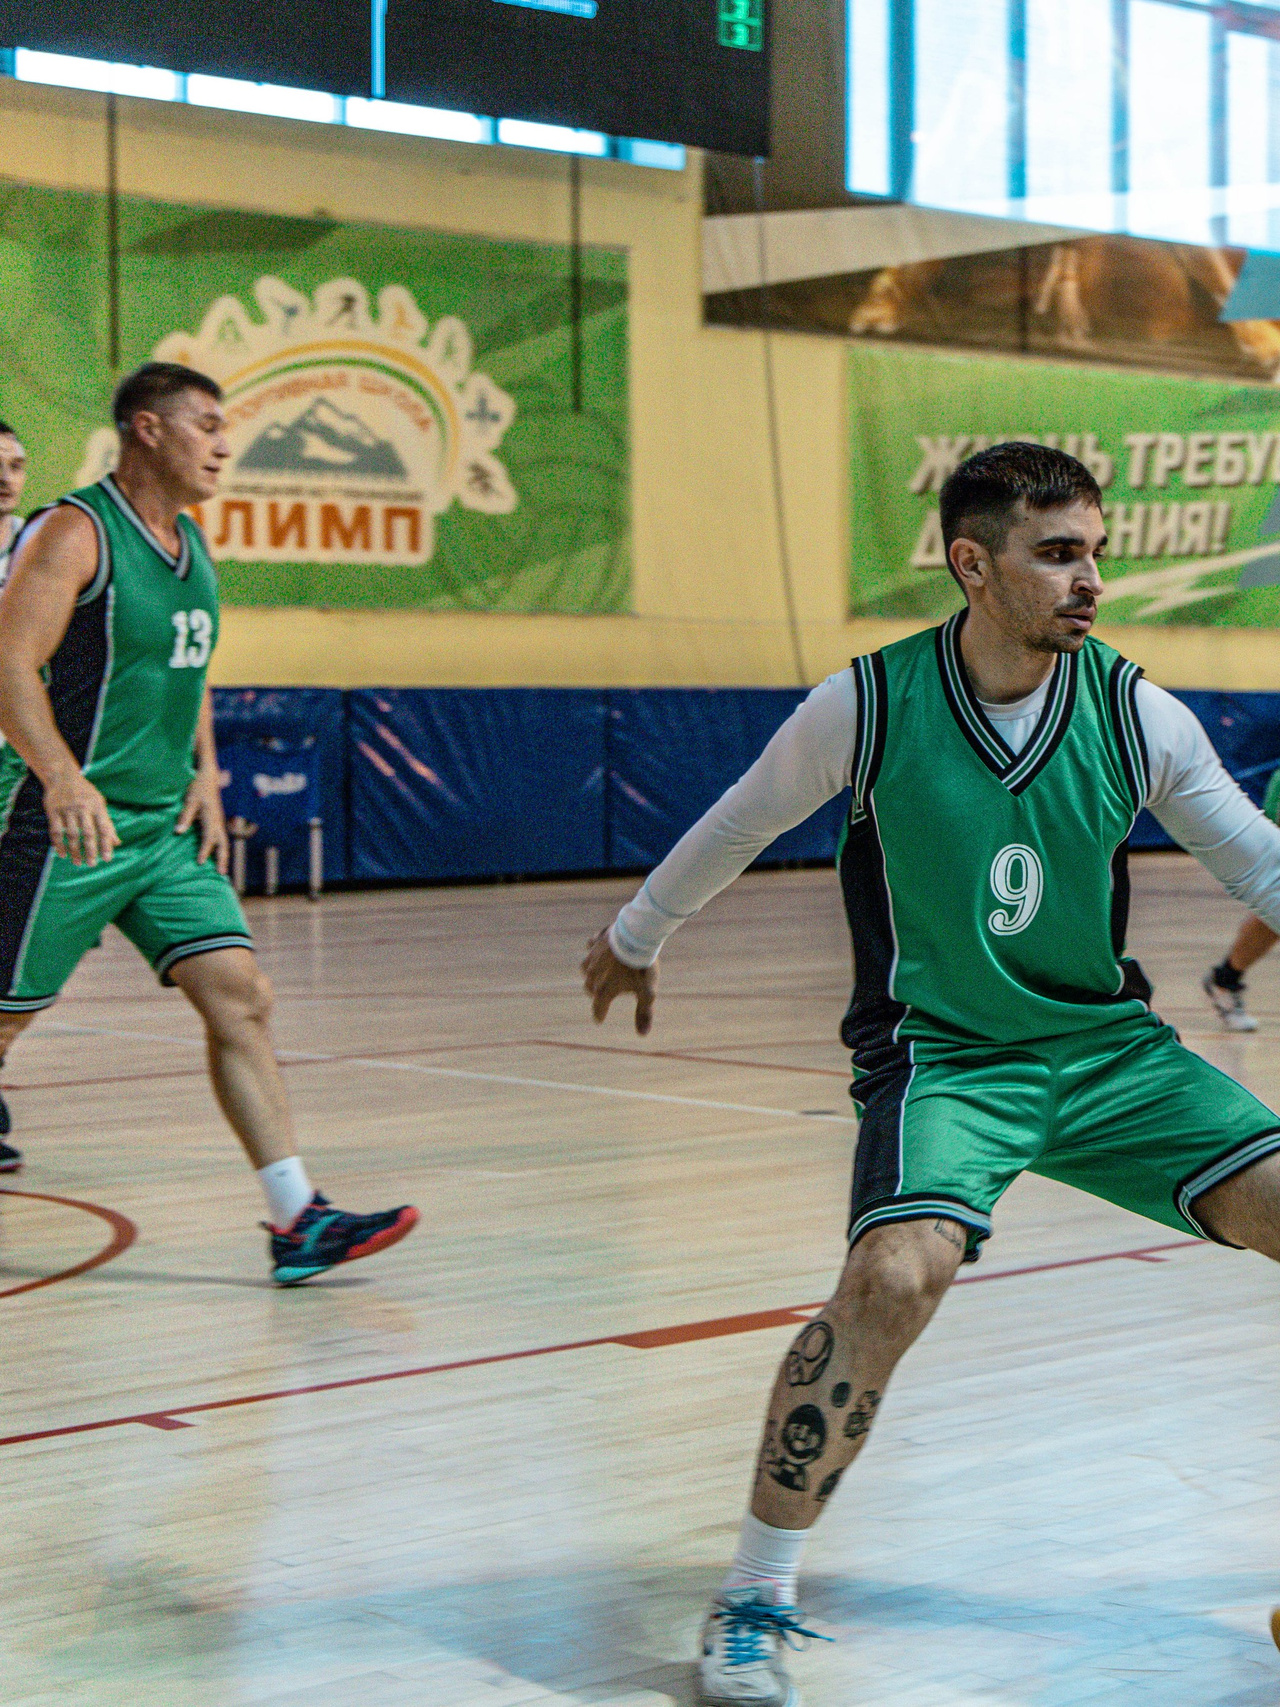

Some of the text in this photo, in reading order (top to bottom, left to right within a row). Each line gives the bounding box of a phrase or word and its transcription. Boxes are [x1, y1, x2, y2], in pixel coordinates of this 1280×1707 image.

[188, 500, 421, 553] ЛИМП
[169, 609, 212, 668] 13
[988, 843, 1044, 936] 9
